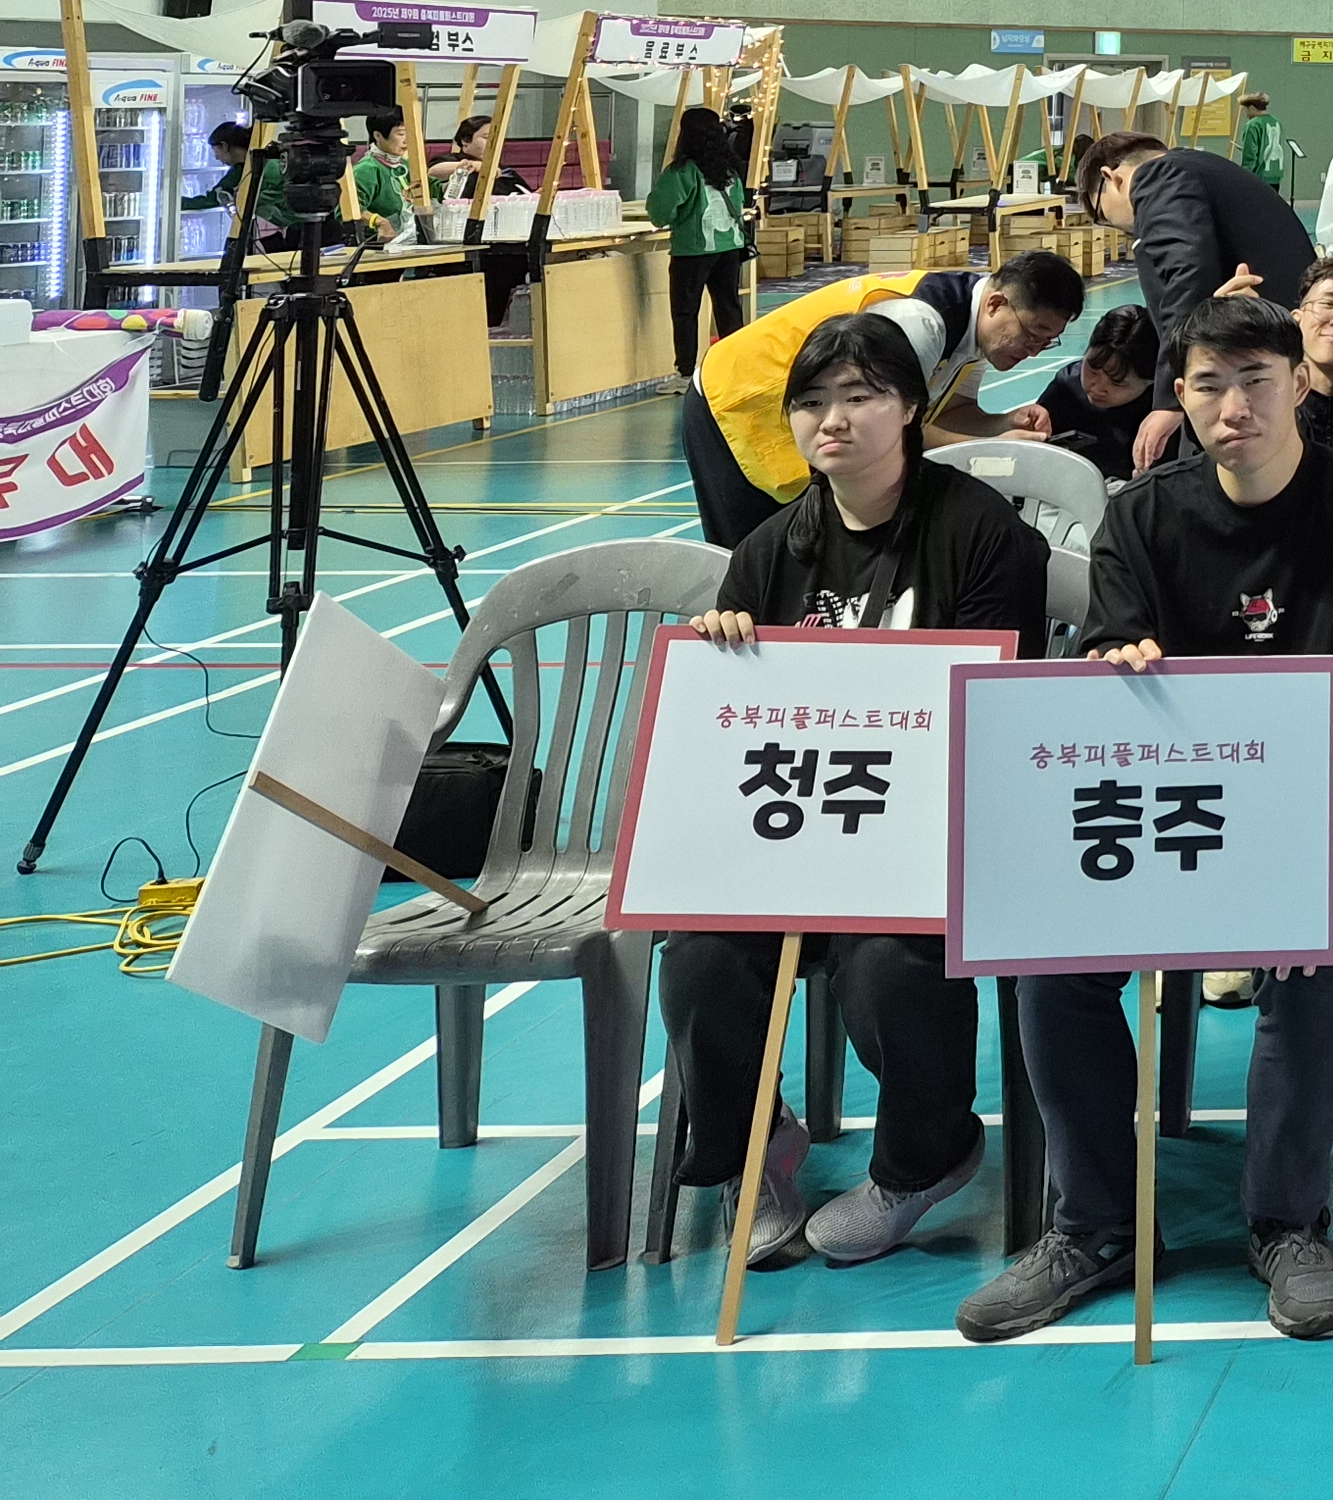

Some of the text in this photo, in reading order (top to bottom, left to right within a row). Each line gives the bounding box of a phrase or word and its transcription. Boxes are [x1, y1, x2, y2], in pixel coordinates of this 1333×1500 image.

[372, 6, 399, 20] 2025년
[447, 31, 474, 52] 부스
[28, 58, 50, 68] Aqua
[113, 93, 158, 103] Aqua FINE
[715, 702, 934, 733] 충북피플퍼스트대회
[1029, 739, 1267, 770] 충북피플퍼스트대회
[738, 741, 894, 840] 청주
[1072, 779, 1227, 882] 충주
